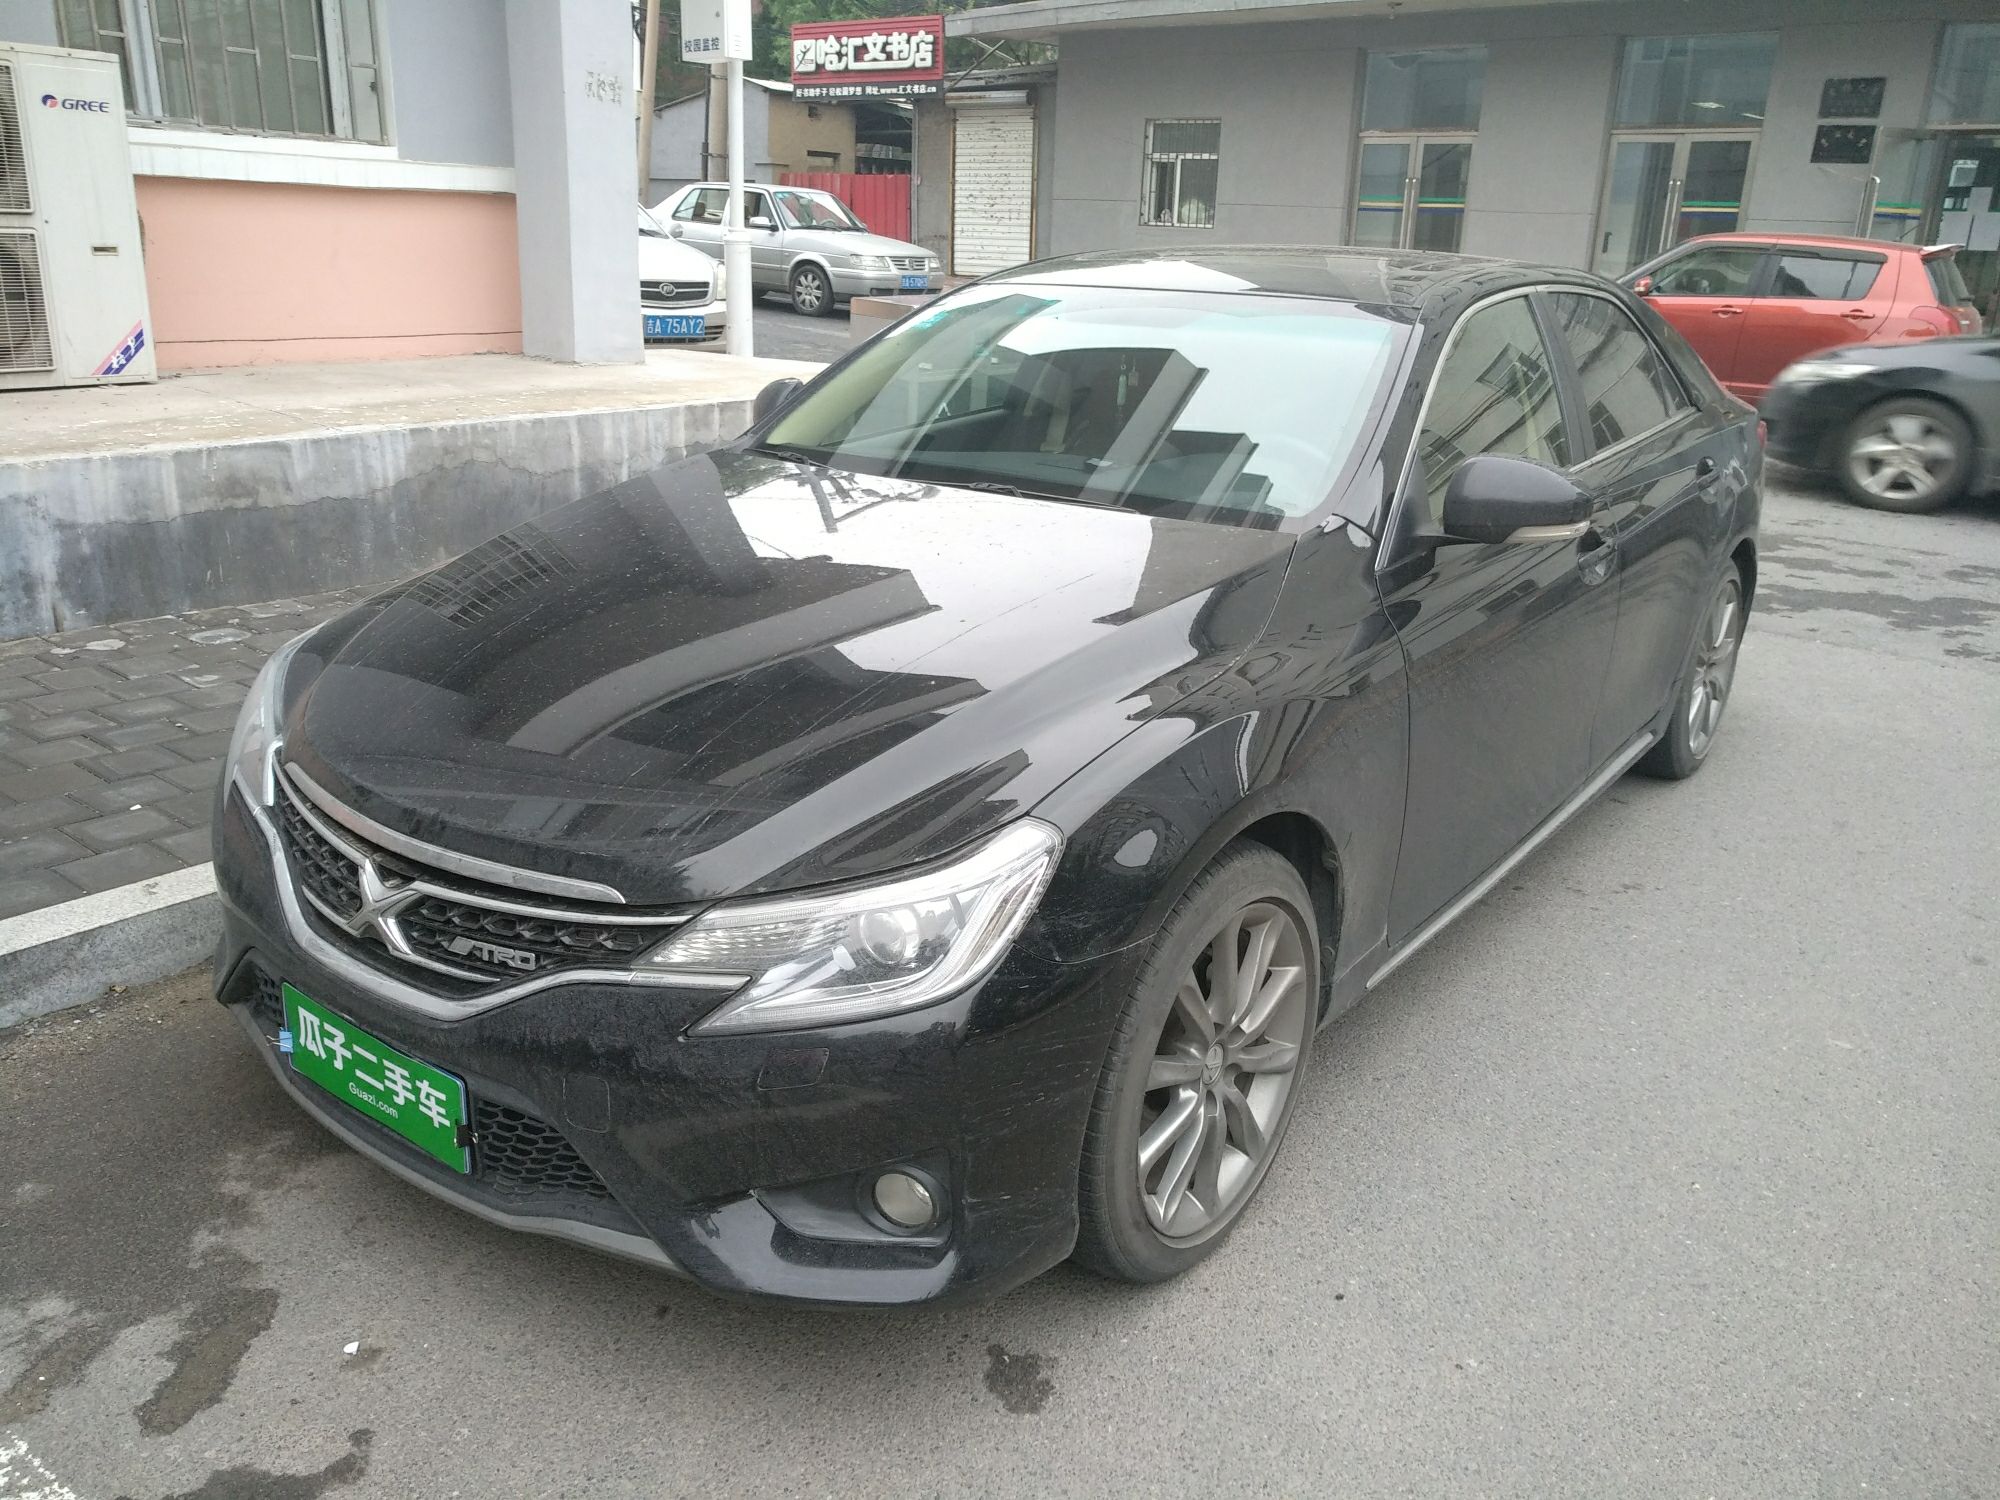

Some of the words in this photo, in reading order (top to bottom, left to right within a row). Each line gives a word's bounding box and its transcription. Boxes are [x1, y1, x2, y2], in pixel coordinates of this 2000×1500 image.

[684, 36, 720, 53] 校园监控
[816, 29, 934, 71] 哈汇文书店
[61, 98, 111, 113] GREE
[472, 940, 536, 971] TRD
[297, 1005, 451, 1128] 瓜子二手车
[348, 1082, 399, 1119] Guazi.com
